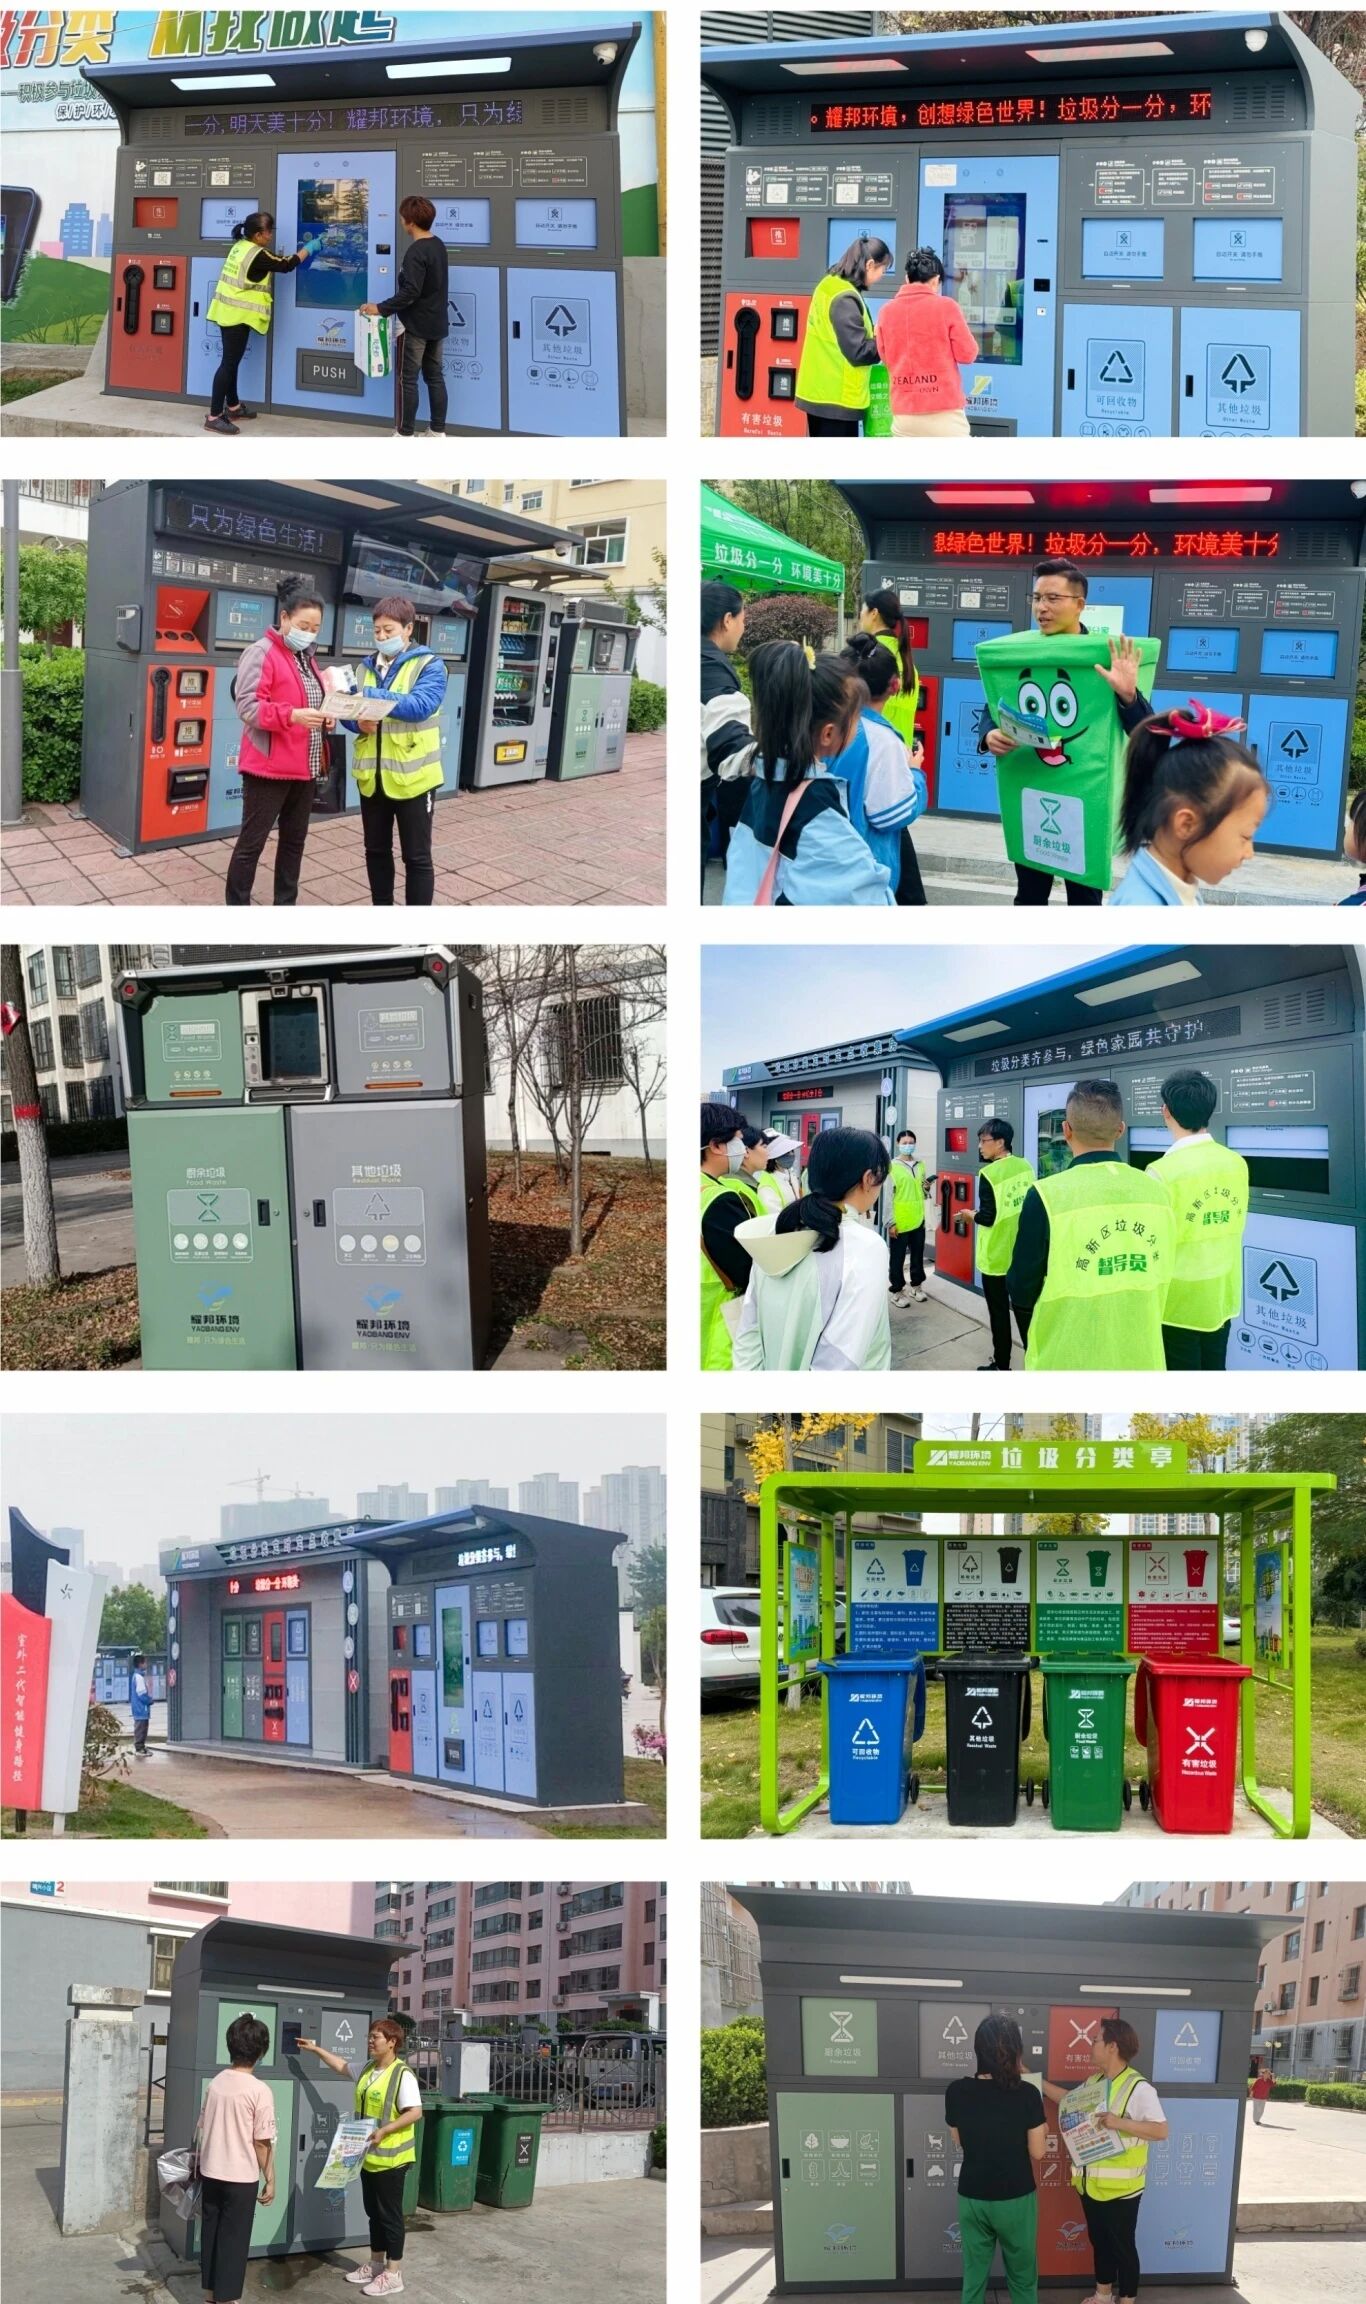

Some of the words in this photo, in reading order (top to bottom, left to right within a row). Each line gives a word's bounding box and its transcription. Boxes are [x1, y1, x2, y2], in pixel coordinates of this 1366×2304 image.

[313, 365, 346, 379] PUSH
[1096, 395, 1137, 408] 可回收物
[1217, 402, 1262, 416] 其他垃圾
[741, 413, 782, 427] 有害垃圾
[714, 542, 783, 575] 垃圾分一分
[791, 562, 841, 589] 环境美十分
[1033, 835, 1071, 854] 厨余垃圾
[186, 1166, 226, 1179] 厨余垃圾
[351, 1163, 402, 1178] 其他垃圾
[1098, 1253, 1147, 1276] 督导员
[190, 1314, 240, 1326] 耀邦环境
[1256, 1304, 1306, 1329] 其他垃圾
[355, 1319, 411, 1332] 耀邦环境
[948, 1450, 992, 1460] 耀邦环境
[1001, 1447, 1173, 1470] 垃圾分类亭
[852, 1748, 880, 1756] 可回收物
[1182, 1758, 1217, 1769] 有害垃圾
[56, 1881, 65, 1893] 2
[824, 2047, 862, 2057] 厨余垃圾
[938, 2051, 973, 2061] 其他垃圾
